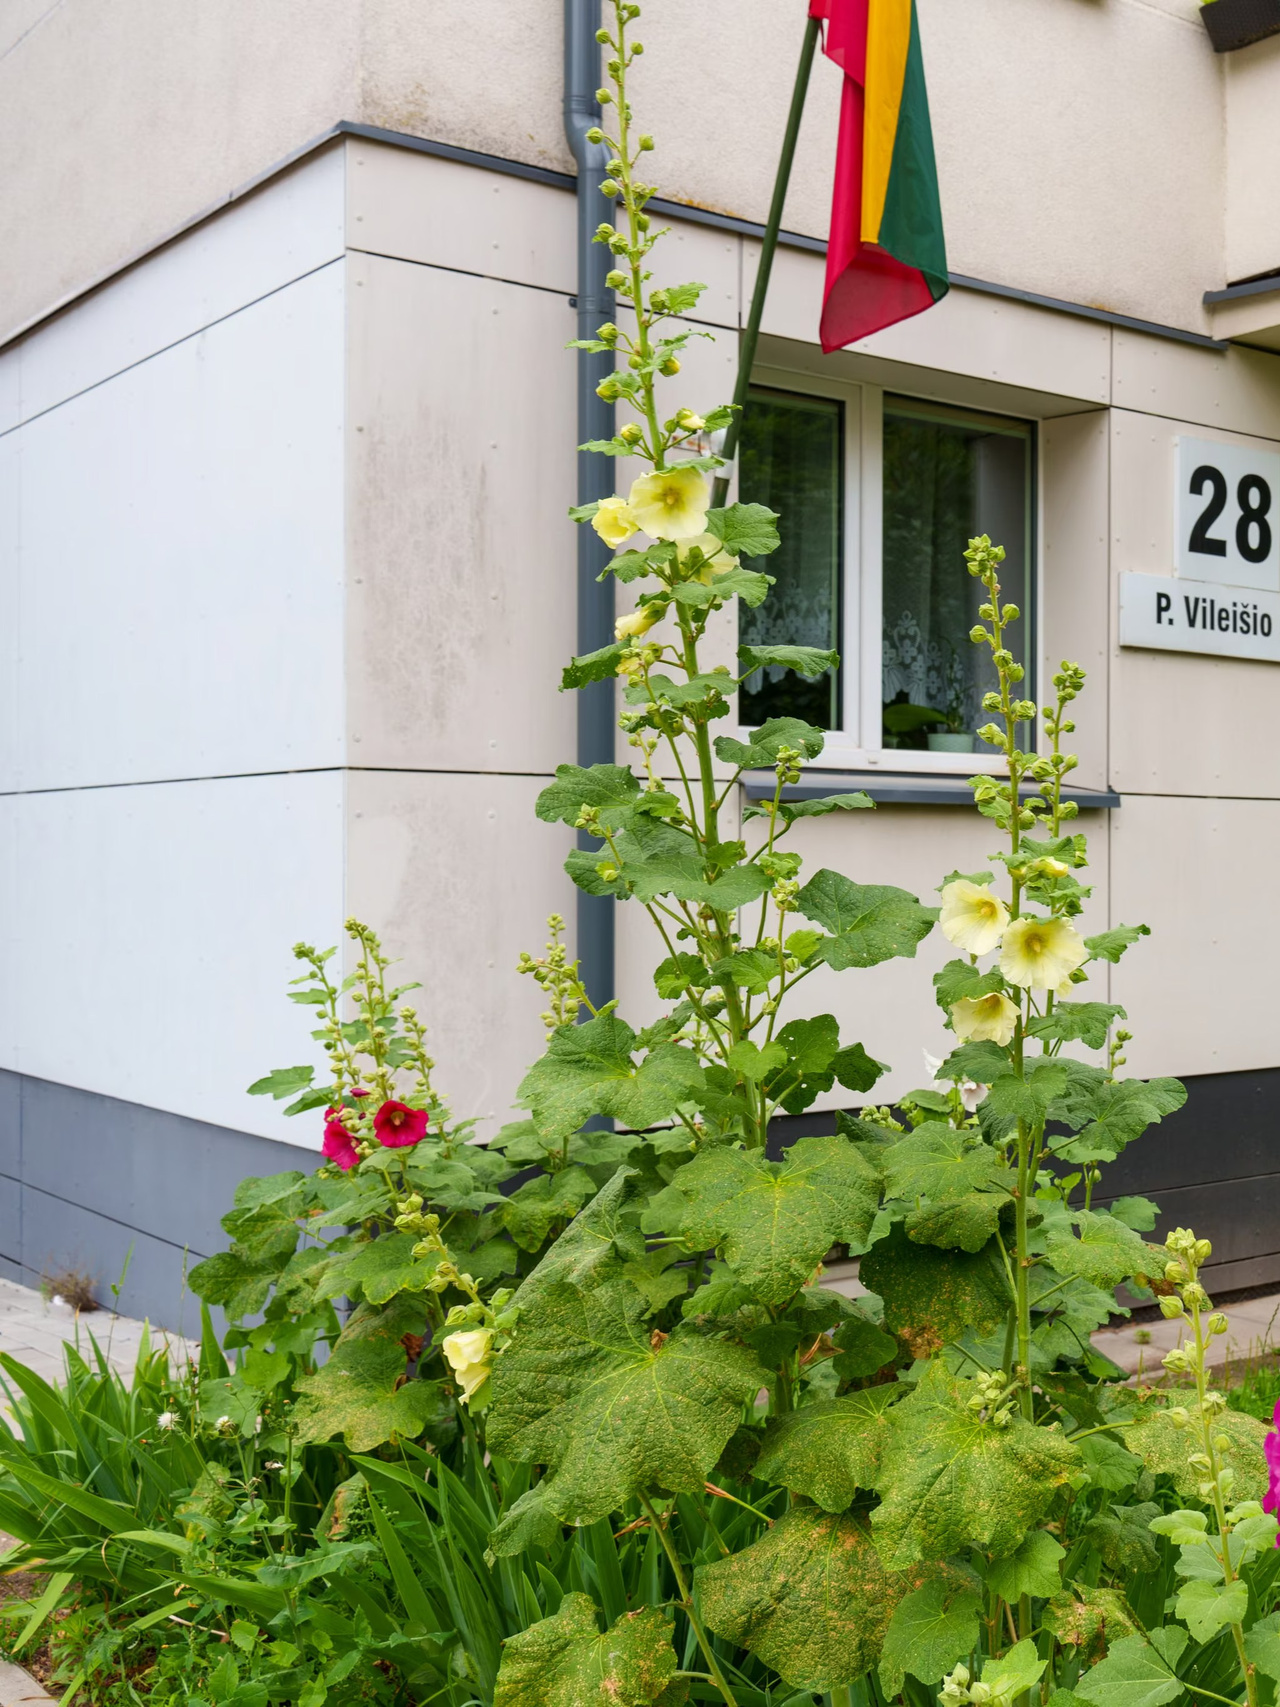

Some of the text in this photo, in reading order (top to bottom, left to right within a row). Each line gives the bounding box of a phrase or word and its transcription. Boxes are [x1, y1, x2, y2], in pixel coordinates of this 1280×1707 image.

[1188, 464, 1273, 564] 28
[1156, 592, 1174, 626] P.
[1184, 595, 1273, 638] Vileišio
